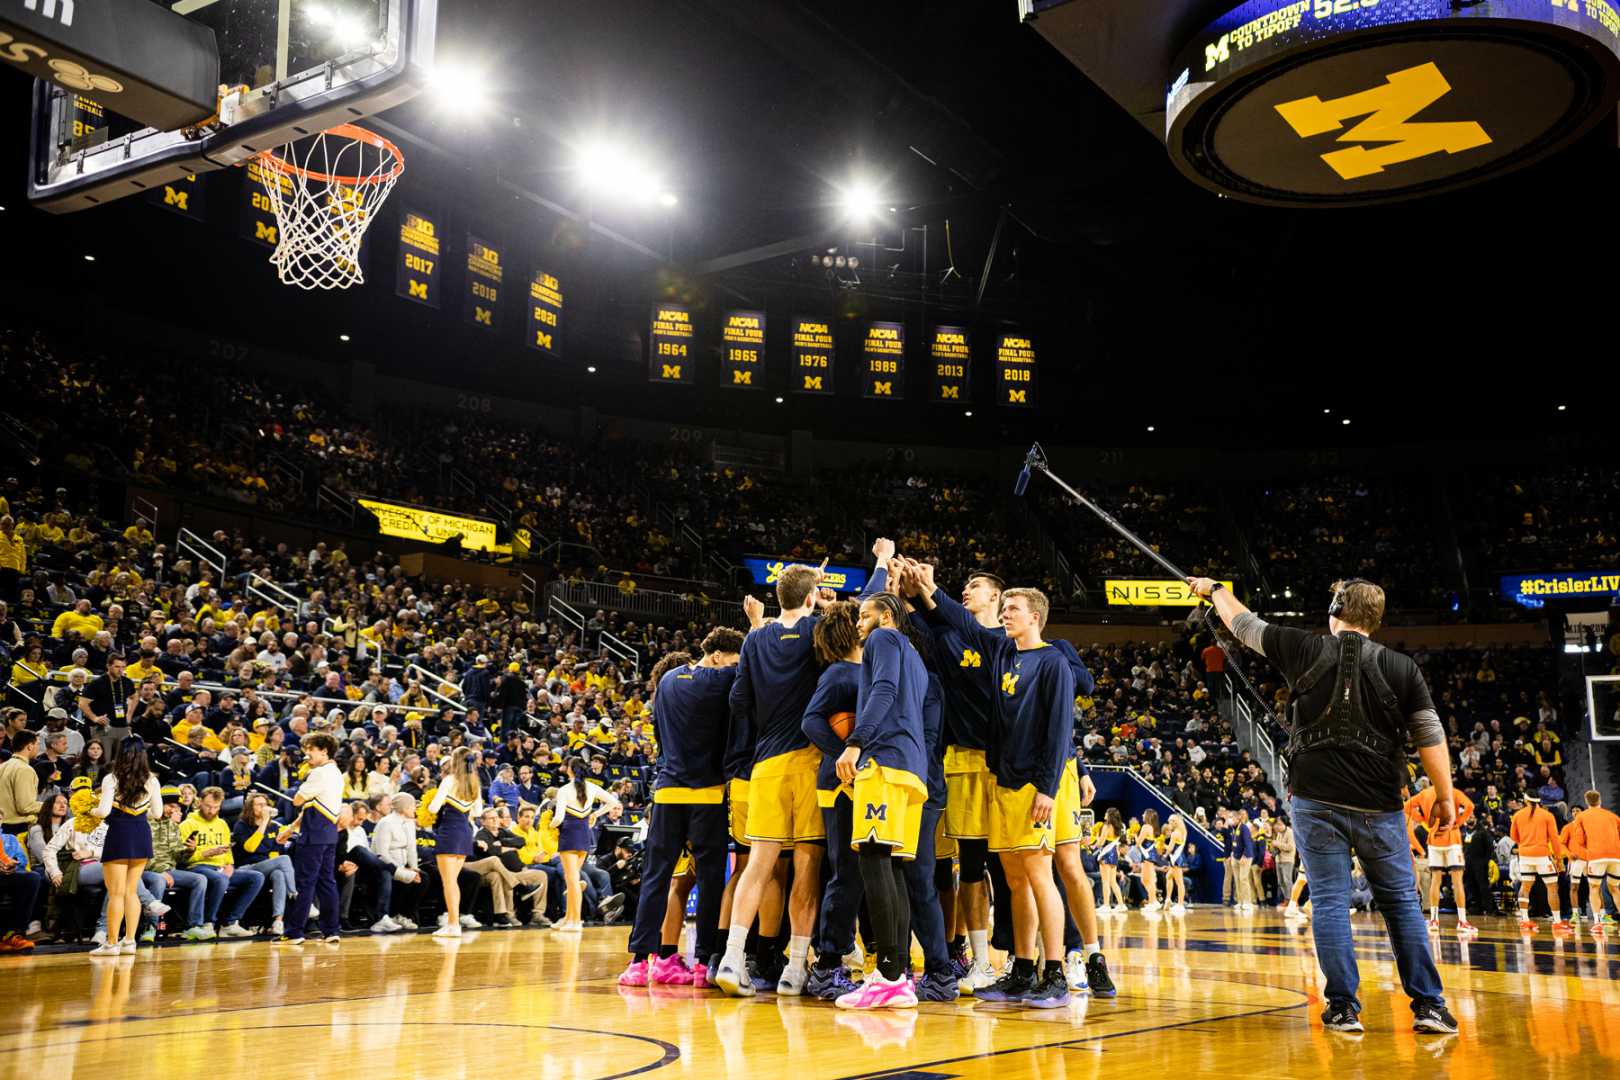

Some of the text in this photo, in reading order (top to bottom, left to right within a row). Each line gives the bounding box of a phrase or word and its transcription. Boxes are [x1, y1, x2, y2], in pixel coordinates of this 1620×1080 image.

[1230, 1, 1310, 43] COUNTDOWN
[1228, 14, 1302, 51] TO TIPOFF
[1205, 33, 1230, 72] M
[1273, 61, 1493, 180] M
[164, 186, 188, 210] M
[255, 221, 278, 244] M
[405, 253, 434, 275] 2017
[409, 279, 428, 300] M
[472, 281, 497, 301] 2018
[475, 306, 492, 325] M
[534, 307, 557, 326] 2021
[659, 311, 689, 322] NCAA
[729, 316, 759, 328] NCAA
[653, 321, 692, 331] FINAL FOUR
[724, 327, 763, 337] FINAL FOUR
[799, 323, 828, 333] NCAA
[536, 330, 553, 349] M
[794, 334, 832, 343] FINAL FOUR
[869, 329, 898, 340] NCAA
[936, 334, 964, 345] NCAA
[658, 343, 687, 356] 1964
[932, 344, 969, 353] FINAL FOUR
[1003, 337, 1031, 349] NCAA
[729, 349, 757, 362] 1965
[998, 348, 1035, 358] FINAL FOUR
[799, 355, 828, 368] 1976
[870, 361, 897, 373] 1989
[662, 364, 681, 378] M
[733, 371, 752, 384] M
[937, 365, 964, 377] 2013
[1004, 369, 1031, 382] 2018
[804, 376, 822, 390] M
[874, 381, 892, 395] M
[941, 385, 959, 398] M
[1008, 389, 1026, 403] M
[456, 392, 491, 412] 208
[380, 517, 419, 532] CREDIT
[428, 514, 441, 525] OF
[444, 518, 494, 535] MICHIGAN
[1113, 586, 1198, 600] NISS
[962, 649, 982, 668] M
[1002, 672, 1020, 695] M
[864, 802, 887, 821] M
